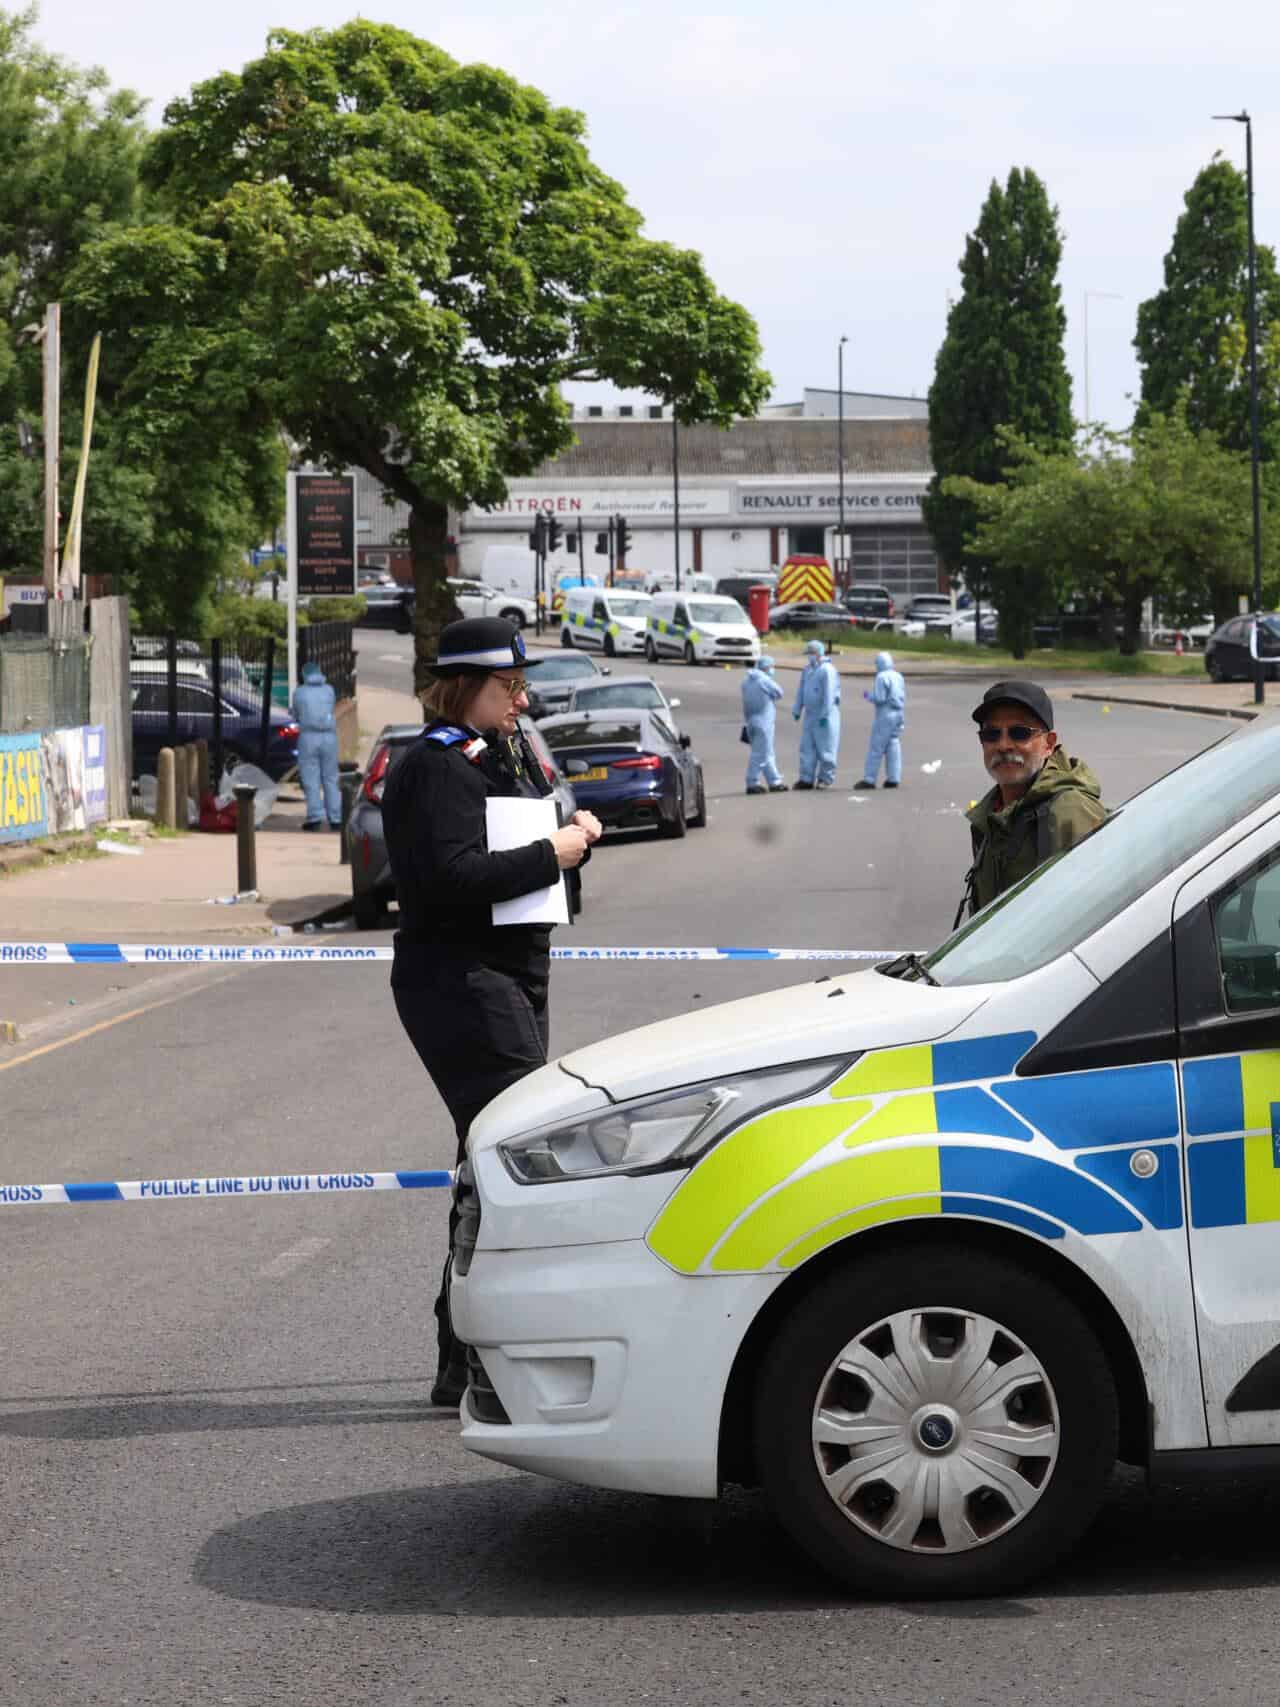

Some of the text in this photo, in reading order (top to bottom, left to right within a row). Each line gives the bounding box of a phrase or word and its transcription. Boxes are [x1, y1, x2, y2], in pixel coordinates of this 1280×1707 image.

[742, 495, 813, 508] RENAULT
[0, 945, 47, 961] ROSS
[145, 947, 203, 960] POLICE
[140, 1179, 200, 1196] POLICE
[206, 1178, 243, 1193] LINE
